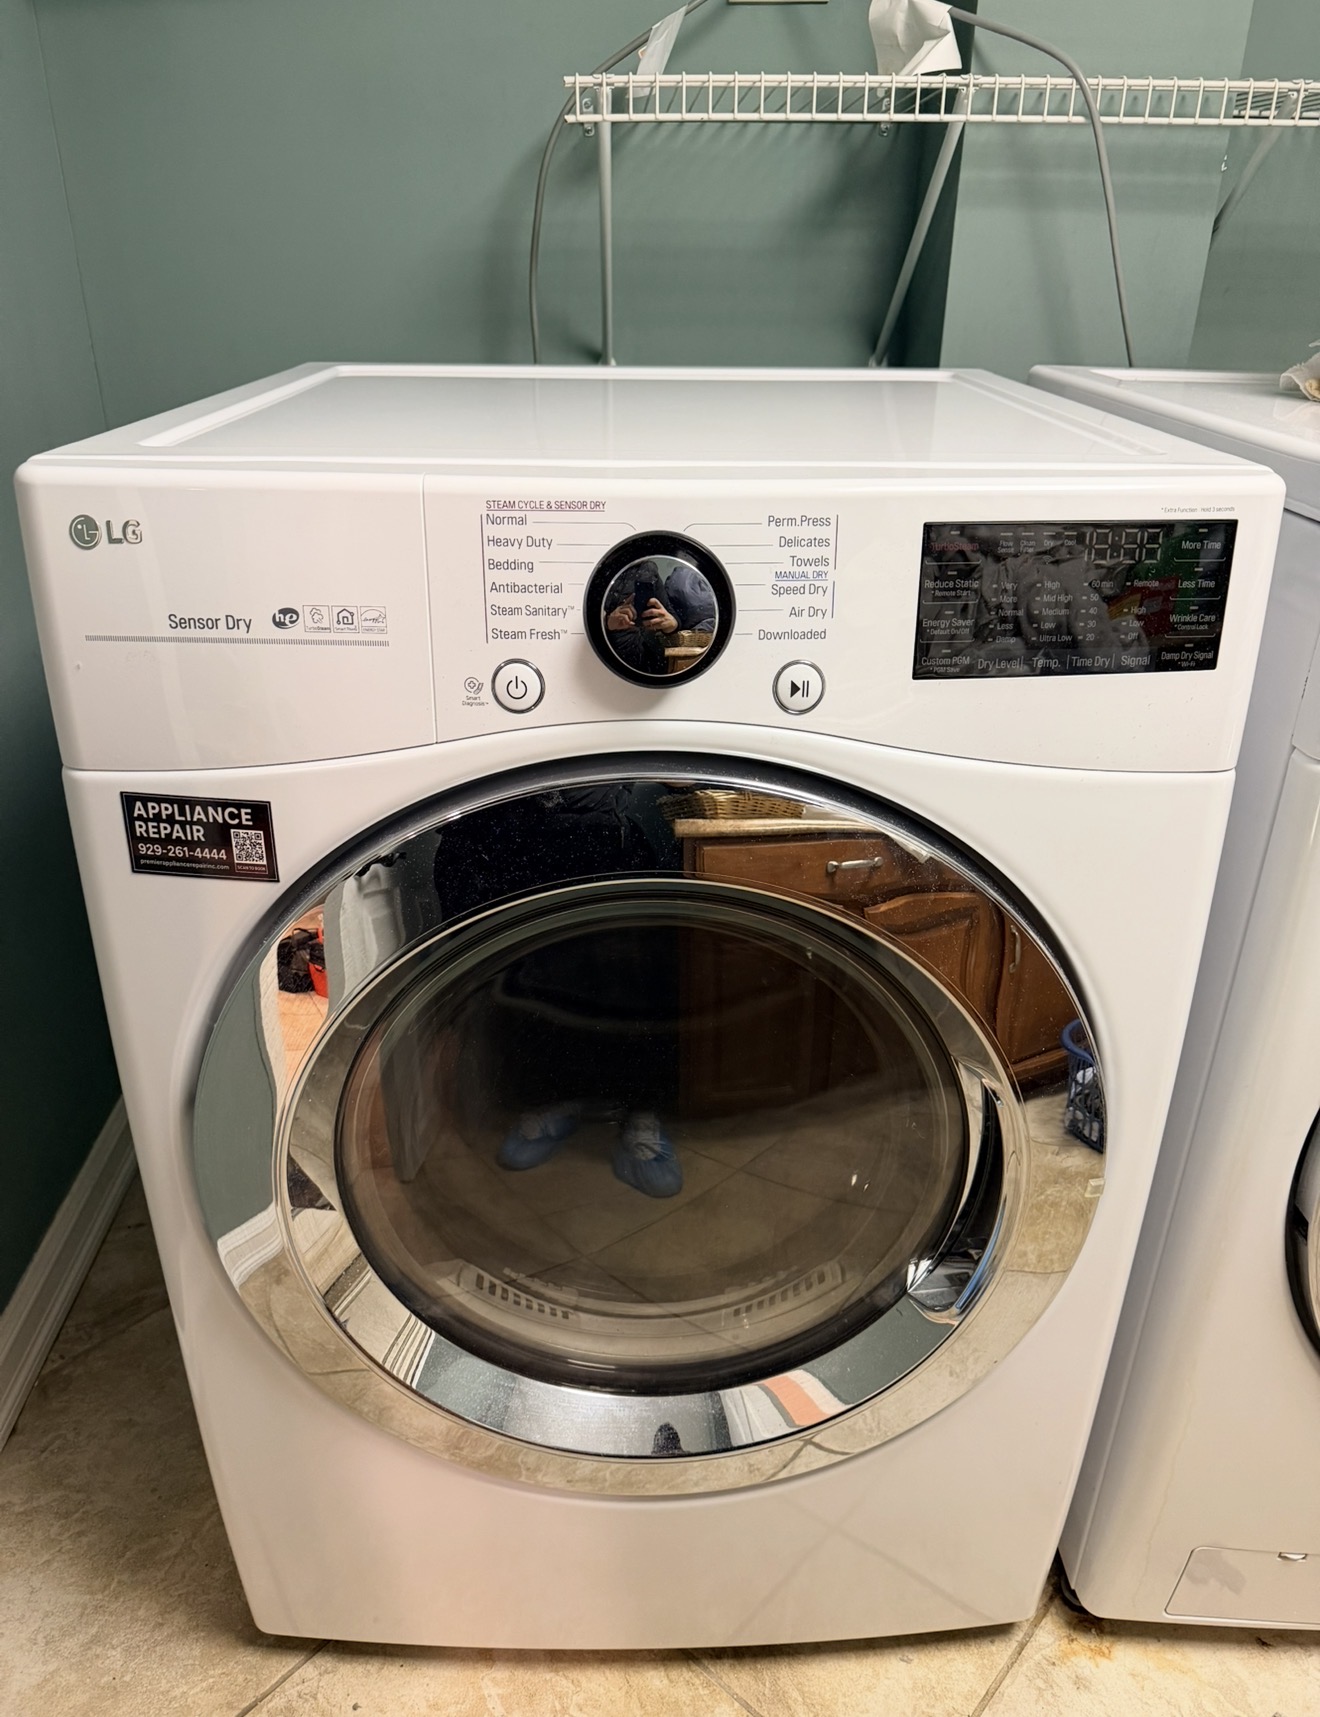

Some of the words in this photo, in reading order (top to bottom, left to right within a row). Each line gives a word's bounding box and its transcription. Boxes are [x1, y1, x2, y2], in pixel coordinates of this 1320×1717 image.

[486, 500, 516, 509] STEAM
[518, 500, 544, 509] CYCLE
[546, 500, 553, 510] &
[554, 501, 588, 510] SENSOR
[589, 501, 606, 510] DRY
[486, 513, 527, 525] Normal
[767, 515, 831, 527] Perm.Press
[106, 519, 143, 544] LG
[487, 535, 523, 549] Heavy
[526, 536, 553, 550] Duty
[778, 536, 830, 548] Delicates
[1181, 541, 1201, 550] More
[1203, 540, 1221, 549] Time
[488, 558, 534, 573] Bedding
[789, 555, 830, 567] Towels
[775, 571, 810, 579] MANUAL
[812, 571, 829, 579] DRY
[490, 582, 563, 594] Antibacterial
[924, 579, 954, 589] Reduce
[955, 579, 979, 588] Static
[1001, 582, 1018, 590] Very
[1044, 581, 1061, 590] High
[1101, 580, 1114, 588] min
[1178, 579, 1195, 588] Less
[1197, 579, 1215, 588] Time
[771, 583, 806, 598] Speed
[808, 584, 828, 597] Dry
[999, 595, 1018, 603] More
[1042, 594, 1056, 602] Mid
[1057, 594, 1073, 603] High
[490, 604, 523, 616] Steam
[789, 606, 805, 618] Air
[808, 606, 827, 619] Dry
[1041, 608, 1069, 616] Medium
[1088, 607, 1098, 615] 40
[1130, 606, 1146, 615] High
[274, 609, 300, 629] he
[922, 619, 950, 628] Energy
[951, 618, 975, 626] Saver
[1169, 614, 1198, 622] Wrinkle
[1199, 613, 1216, 622] Care
[168, 614, 221, 630] Sensor
[225, 615, 252, 634] Dry
[1040, 621, 1056, 629] Low
[1087, 620, 1096, 628] 30
[491, 628, 527, 640] Steam
[758, 629, 827, 640] Downloaded
[1085, 633, 1095, 641] 20
[921, 657, 951, 666] Custom
[952, 656, 970, 665] PGM
[1071, 657, 1093, 667] Time
[1094, 656, 1110, 668] Dry
[1120, 655, 1150, 667] Signal
[1161, 652, 1180, 661] Damp
[1180, 651, 1193, 661] Dry
[1193, 651, 1214, 661] Signal
[977, 659, 994, 671] Dry
[995, 658, 1020, 669] Level
[1032, 657, 1061, 669] Temp.
[133, 801, 253, 826] APPLIANCE
[134, 821, 206, 842] REPAIR
[138, 843, 227, 860] 929-261-4444
[140, 858, 230, 870] premierappliancerepairinc.com
